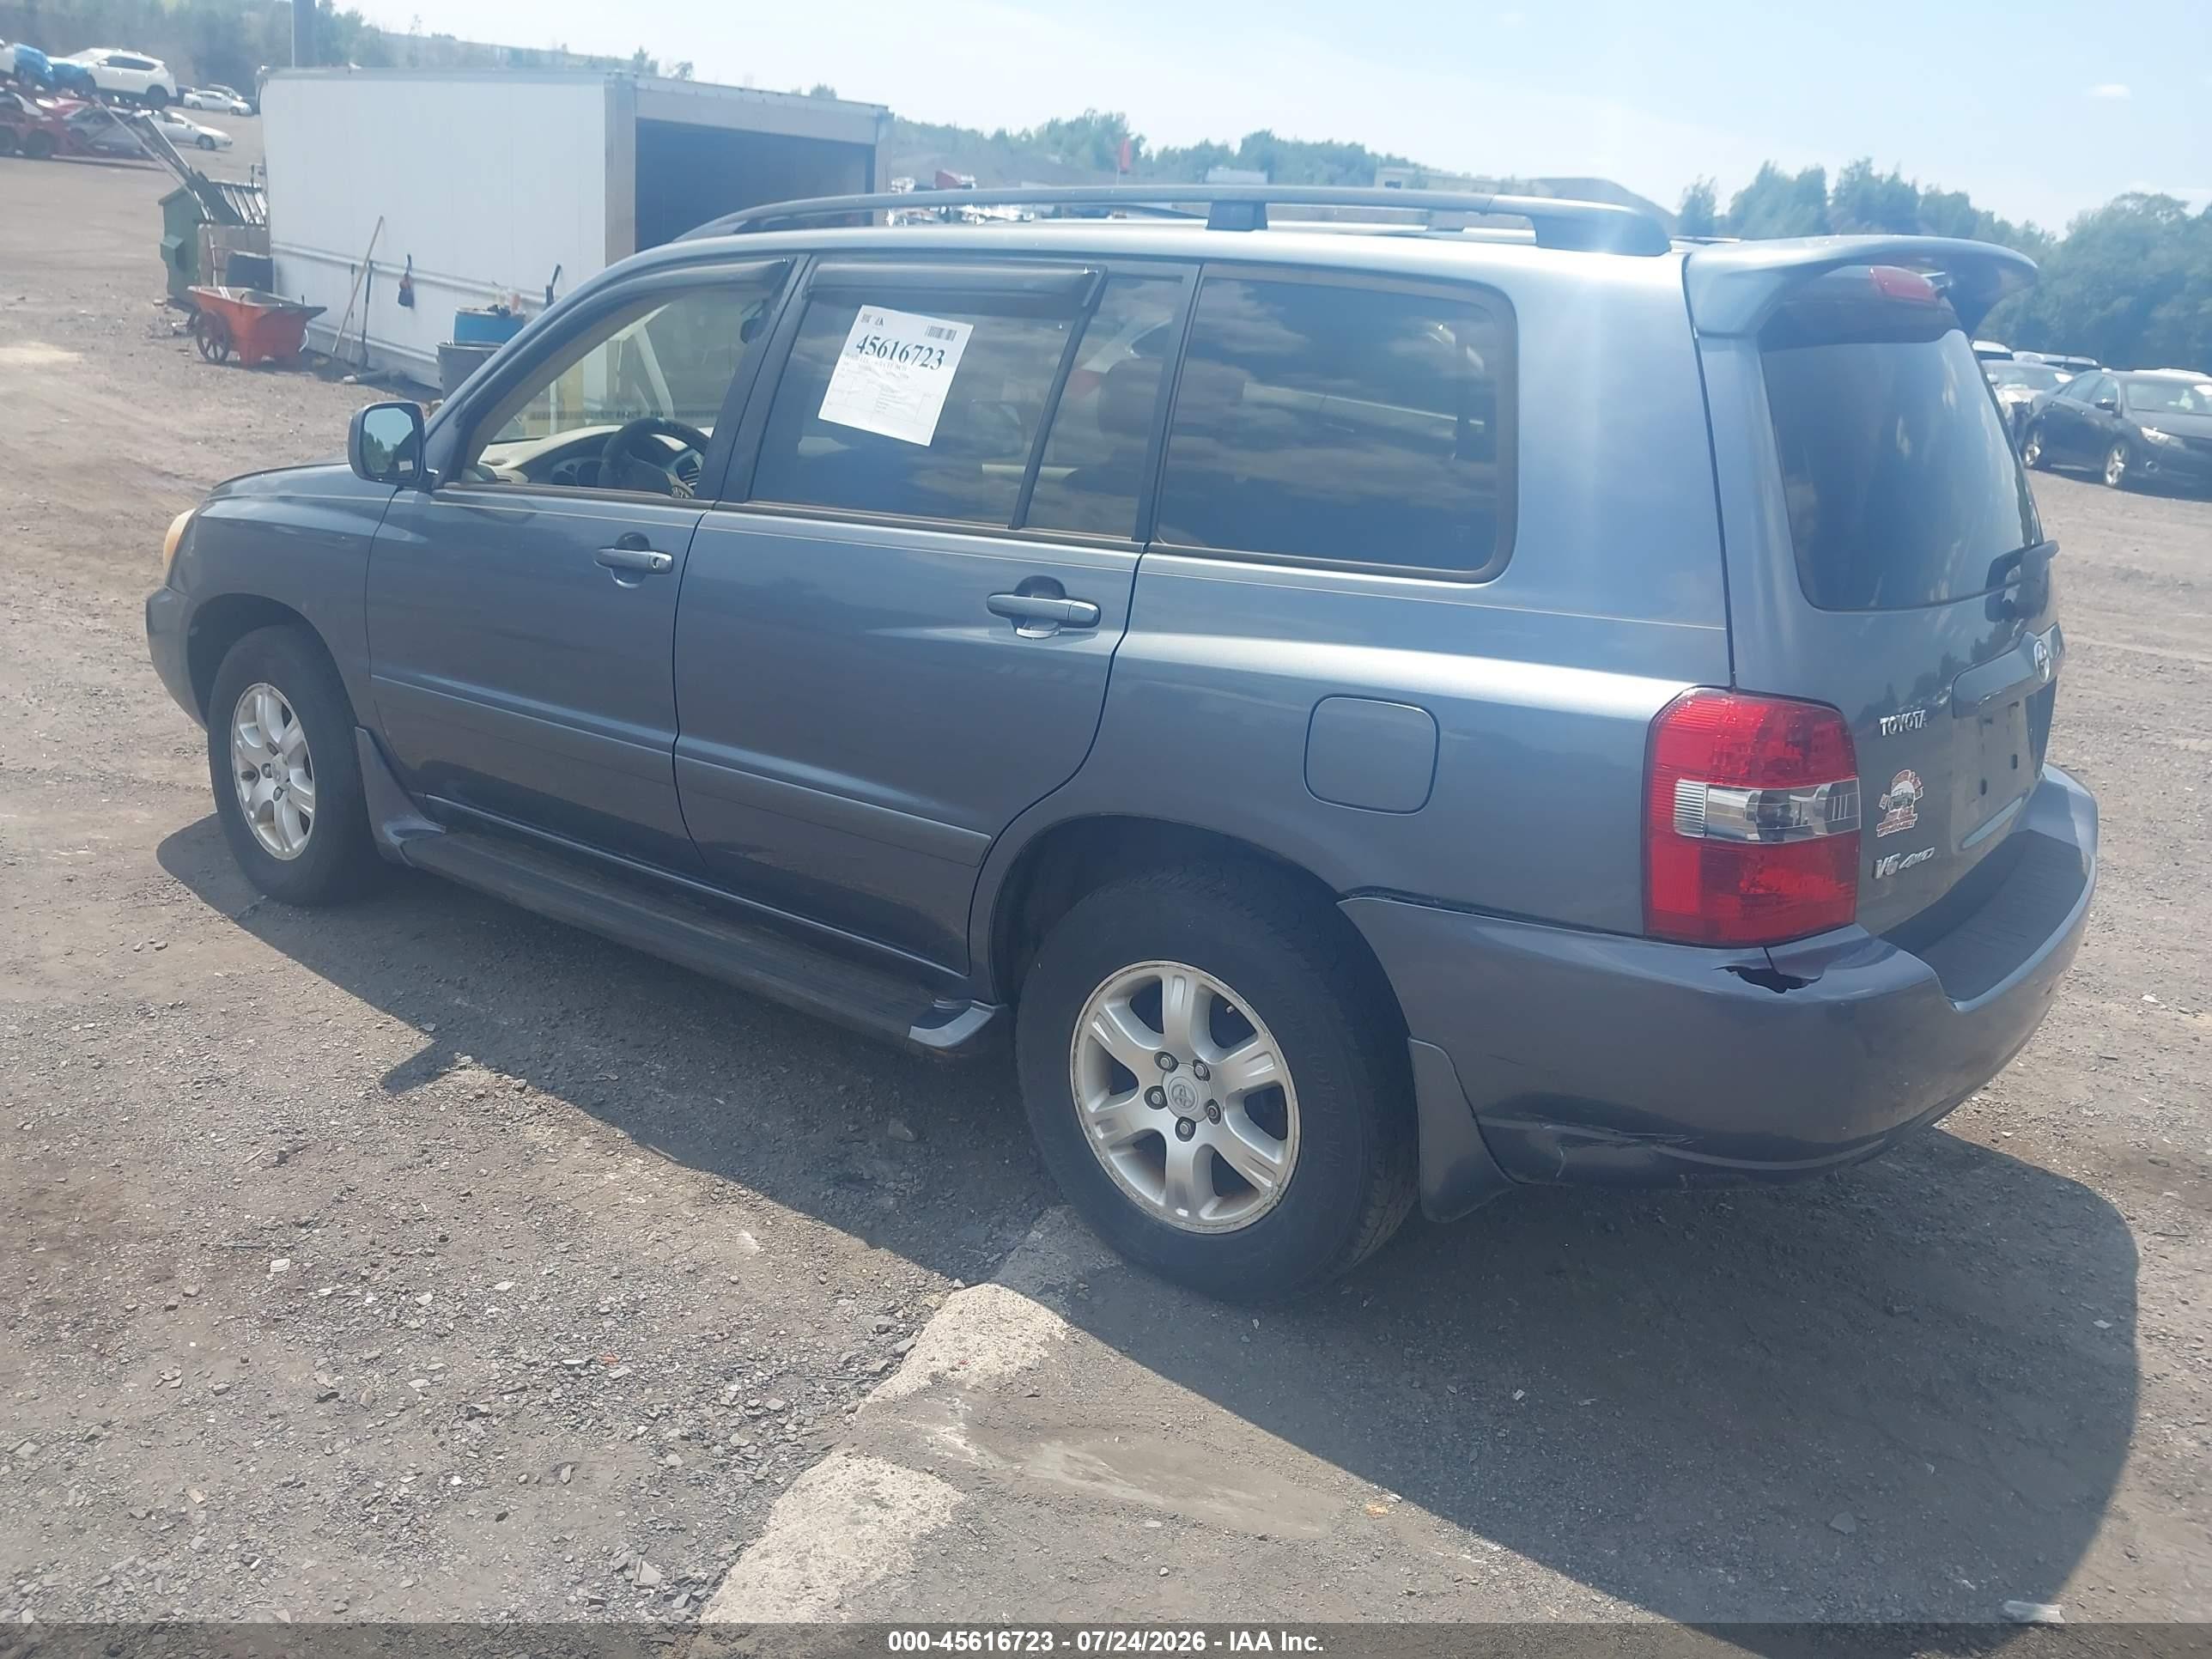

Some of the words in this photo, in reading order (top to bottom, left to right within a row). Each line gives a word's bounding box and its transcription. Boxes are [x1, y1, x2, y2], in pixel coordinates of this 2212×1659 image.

[856, 334, 945, 370] 45616723
[1880, 709, 1929, 736] TOYOTA
[1875, 853, 1900, 879] V6
